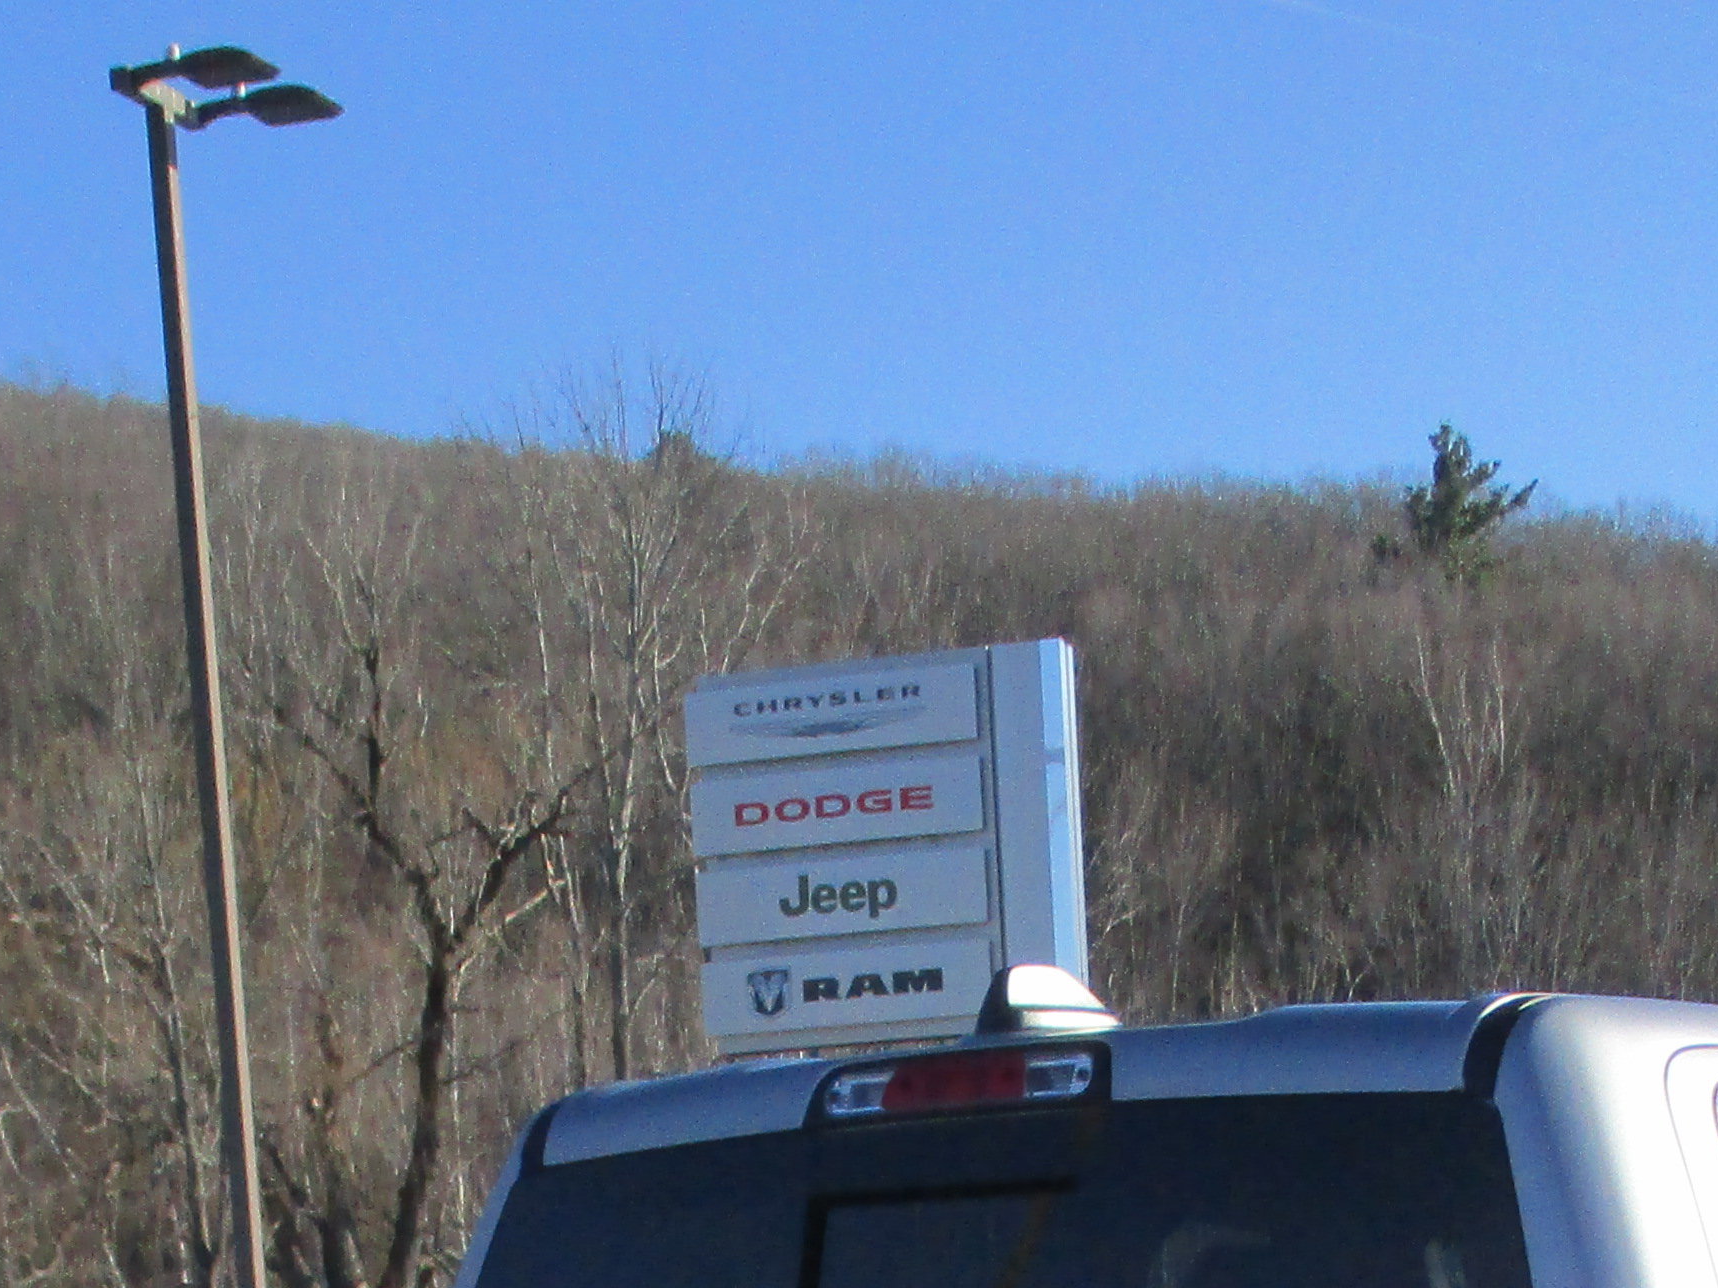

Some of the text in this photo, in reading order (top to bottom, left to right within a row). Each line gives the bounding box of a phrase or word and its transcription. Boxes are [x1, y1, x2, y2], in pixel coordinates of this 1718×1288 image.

[733, 684, 921, 718] CHRYSLER
[733, 785, 935, 828] DODGE
[778, 874, 898, 919] Jeep
[802, 967, 944, 1003] RAM
